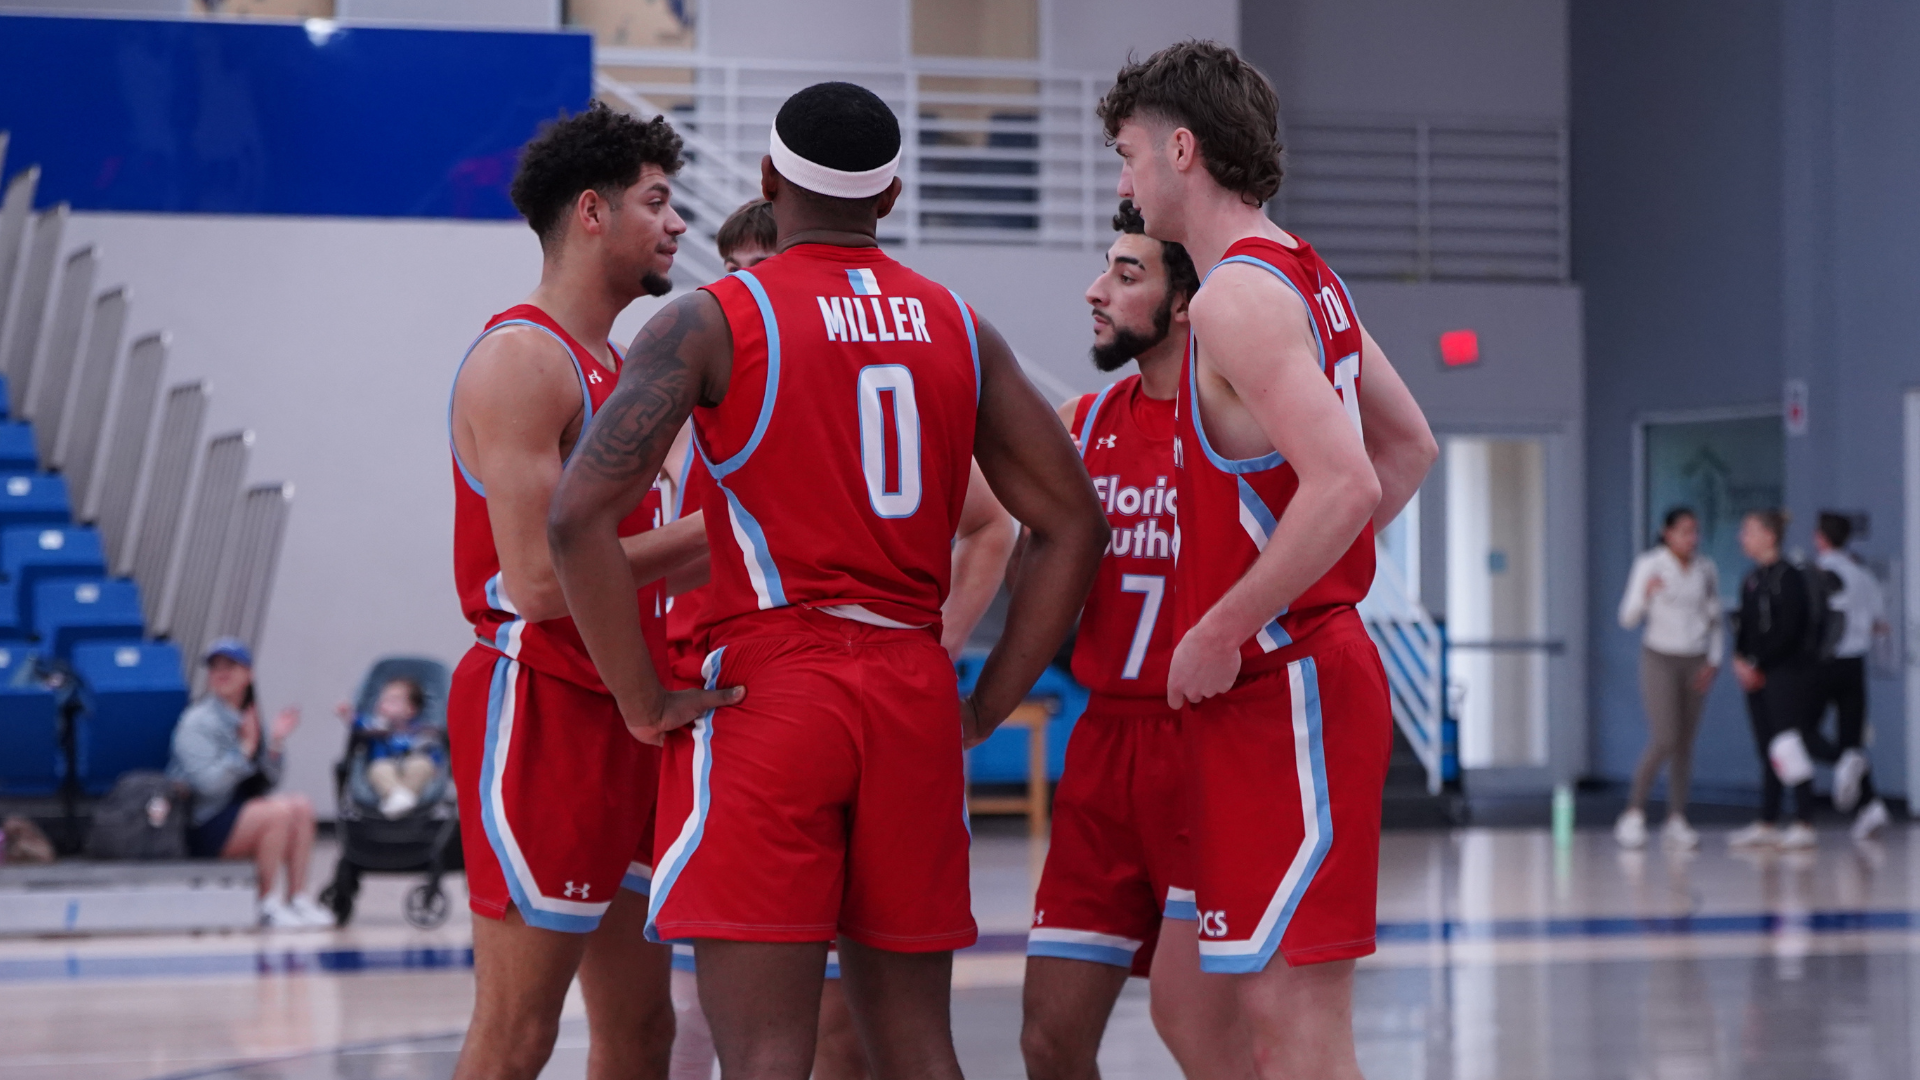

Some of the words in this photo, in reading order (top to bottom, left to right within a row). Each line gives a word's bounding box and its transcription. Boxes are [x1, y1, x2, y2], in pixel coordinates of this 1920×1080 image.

[816, 295, 932, 343] MILLER
[857, 363, 923, 519] 0
[1120, 573, 1166, 680] 7
